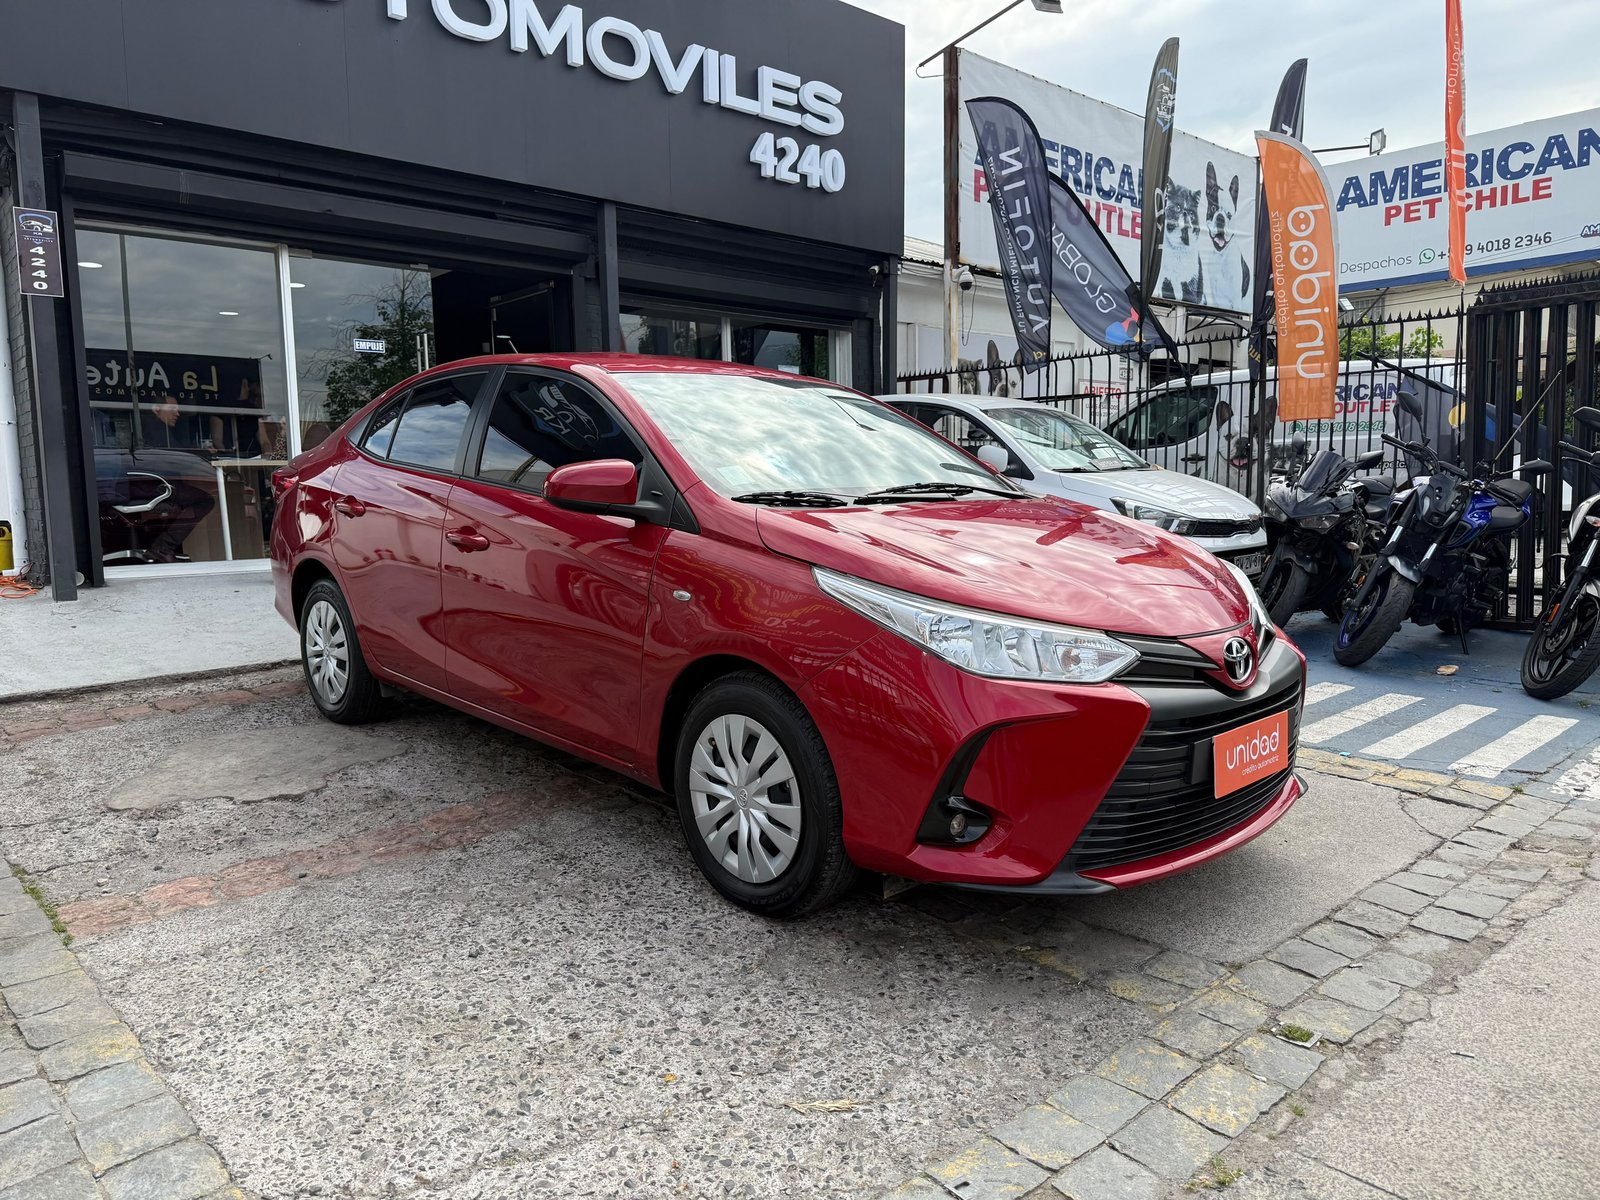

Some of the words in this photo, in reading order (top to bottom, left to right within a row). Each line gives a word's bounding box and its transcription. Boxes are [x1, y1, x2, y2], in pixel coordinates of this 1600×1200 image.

[386, 0, 845, 137] OMOVILES
[749, 131, 846, 193] 4240
[974, 120, 1144, 209] AMERICA
[1384, 197, 1442, 227] PET
[1340, 255, 1412, 274] Despachos
[1477, 238, 1511, 254] 4018
[1514, 231, 1553, 248] 2346
[29, 246, 49, 290] 4240
[355, 341, 384, 351] EMPUJE
[1226, 722, 1280, 770] unidad
